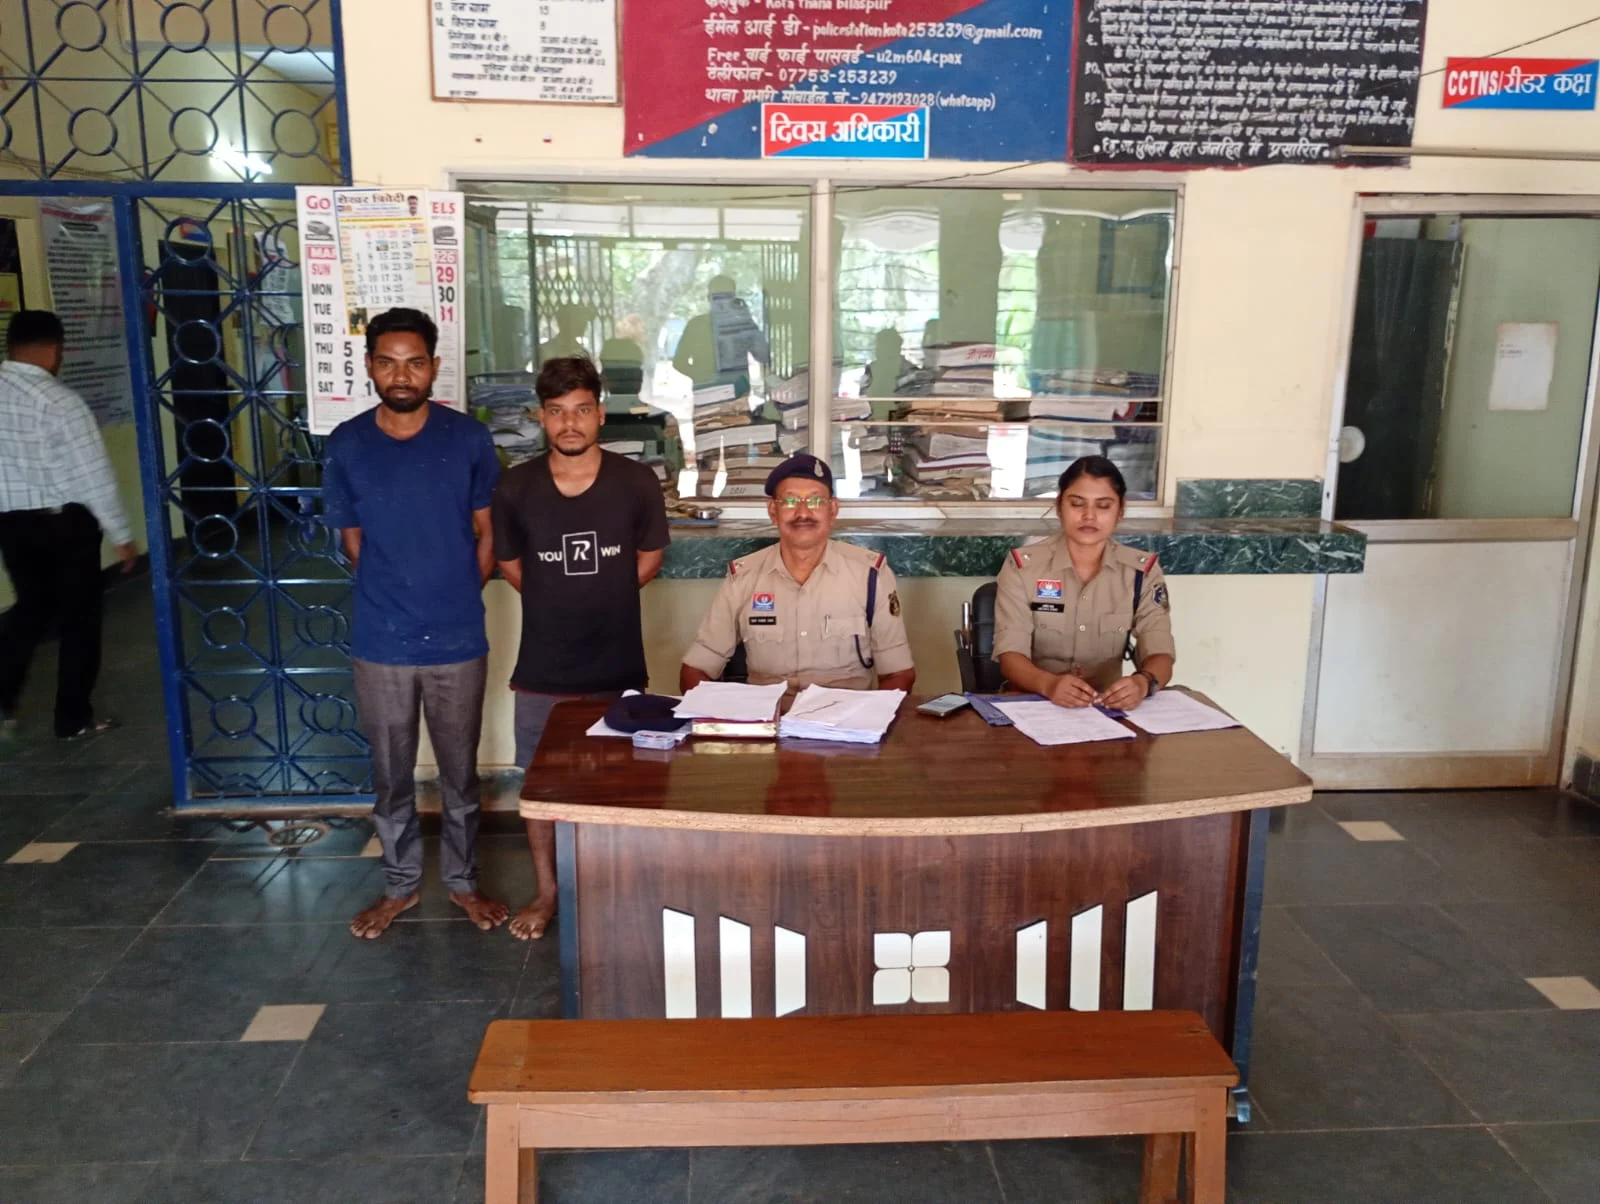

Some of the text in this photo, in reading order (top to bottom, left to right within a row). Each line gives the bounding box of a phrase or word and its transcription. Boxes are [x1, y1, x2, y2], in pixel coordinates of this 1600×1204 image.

[744, 14, 776, 37] आई
[781, 14, 802, 36] डी
[707, 48, 740, 61] Free
[744, 42, 772, 63] वाई
[777, 42, 811, 64] फाई
[778, 68, 898, 84] 07753-253239
[1553, 73, 1593, 96] कक्ष
[705, 88, 740, 103] थाना
[769, 112, 920, 143] दिवस अधिकारी
[1248, 136, 1264, 157] में
[432, 202, 456, 214] ELS
[311, 263, 331, 275] SUN
[436, 266, 455, 283] 29
[311, 283, 333, 296] MON
[314, 303, 332, 315] TUE
[313, 322, 333, 335] WED
[315, 341, 353, 357] THU 5
[317, 360, 353, 377] FRI 6
[317, 381, 334, 393] SAT
[344, 380, 354, 396] 7
[537, 540, 621, 562] YOU R WIN
